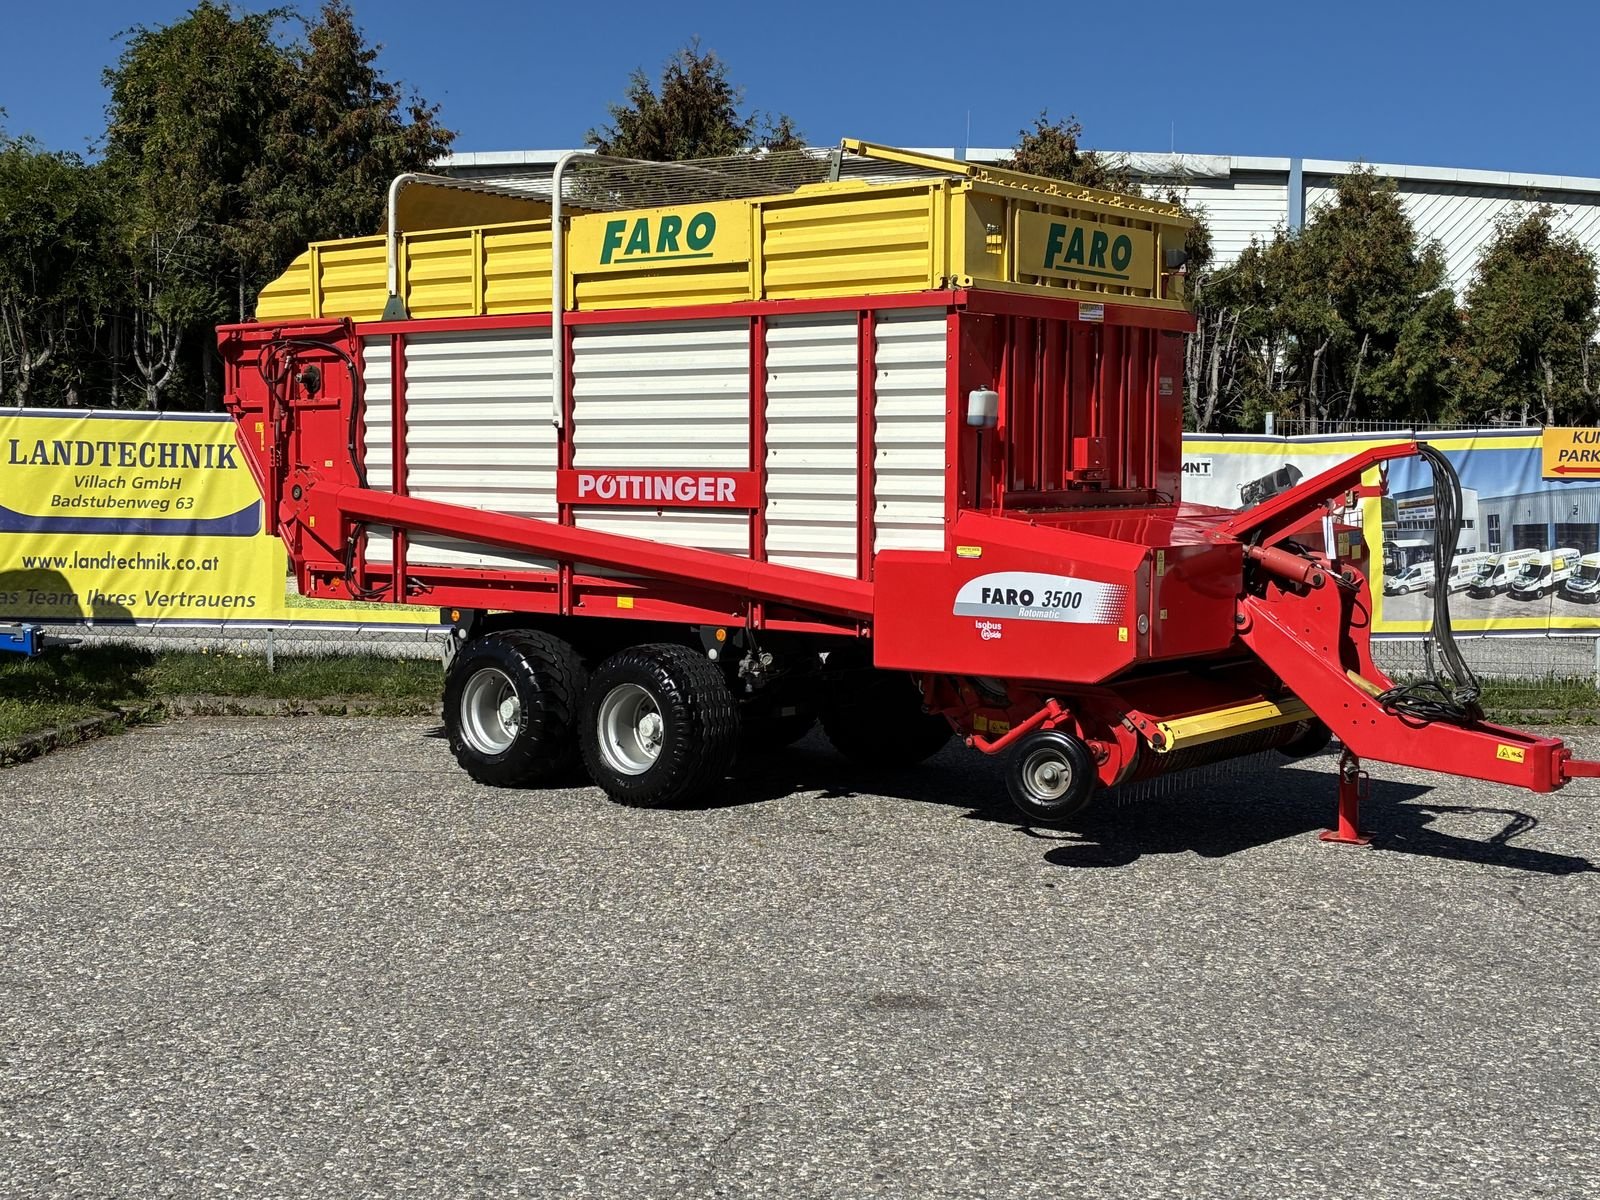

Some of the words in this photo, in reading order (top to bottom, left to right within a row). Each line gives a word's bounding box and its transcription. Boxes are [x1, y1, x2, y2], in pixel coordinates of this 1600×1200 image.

[600, 212, 716, 265] FARO
[1044, 223, 1132, 272] FARO
[8, 439, 238, 469] LANDTECHNIK
[74, 475, 126, 489] Villach
[132, 476, 181, 490] GmbH
[578, 474, 736, 502] PÖTTINGER
[51, 495, 170, 512] Badstubenweg
[175, 497, 194, 509] 63
[22, 551, 219, 570] www.landtechnik.co.at
[26, 588, 79, 606] Team
[86, 589, 137, 606] Ihres
[145, 590, 256, 608] Vertrauens
[981, 588, 1034, 606] FARO
[1041, 591, 1082, 609] 3500
[1018, 607, 1060, 619] Rotomatic
[976, 620, 1001, 630] Isobus
